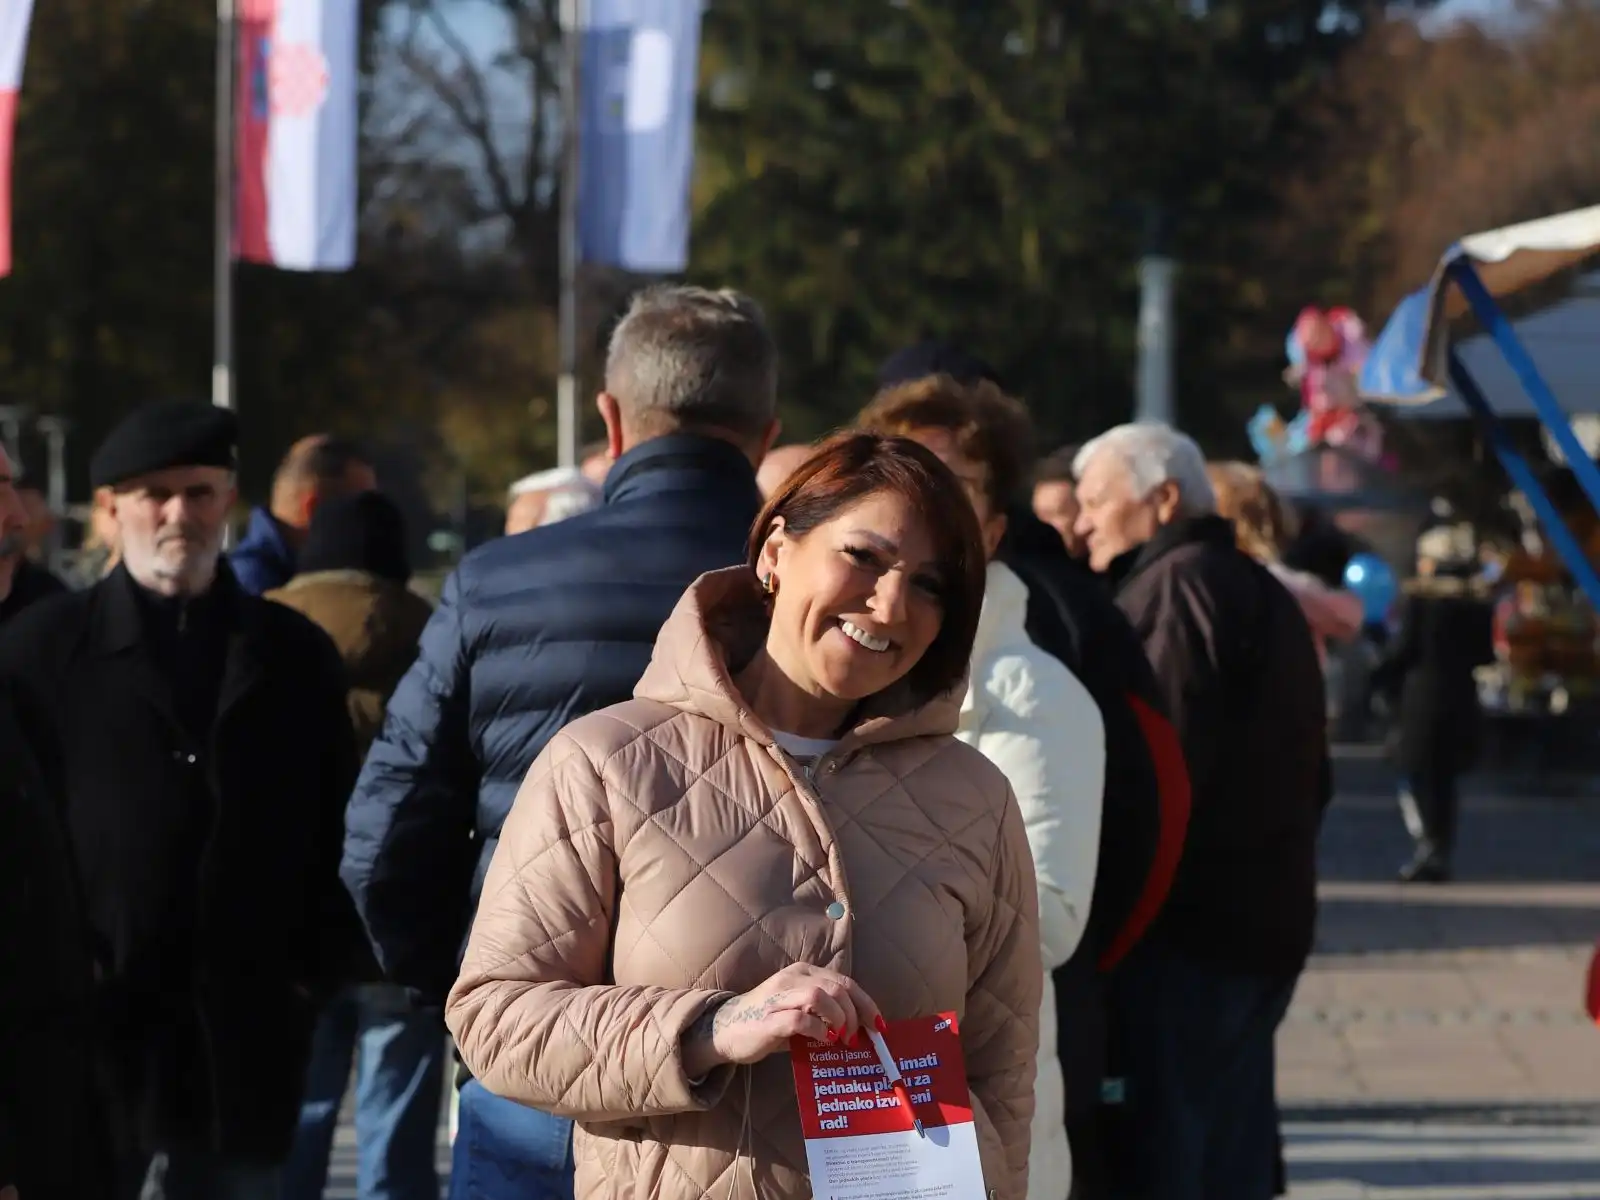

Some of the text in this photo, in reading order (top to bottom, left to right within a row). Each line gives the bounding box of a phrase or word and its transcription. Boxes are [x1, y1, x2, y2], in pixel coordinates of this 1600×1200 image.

[934, 1018, 952, 1033] SDP
[809, 1050, 839, 1062] Kratko
[845, 1049, 872, 1062] jasno:
[812, 1053, 938, 1079] žene mora imati
[814, 1074, 931, 1100] jednaku plau za
[817, 1089, 932, 1117] jednako izvreni
[820, 1115, 849, 1130] rad!
